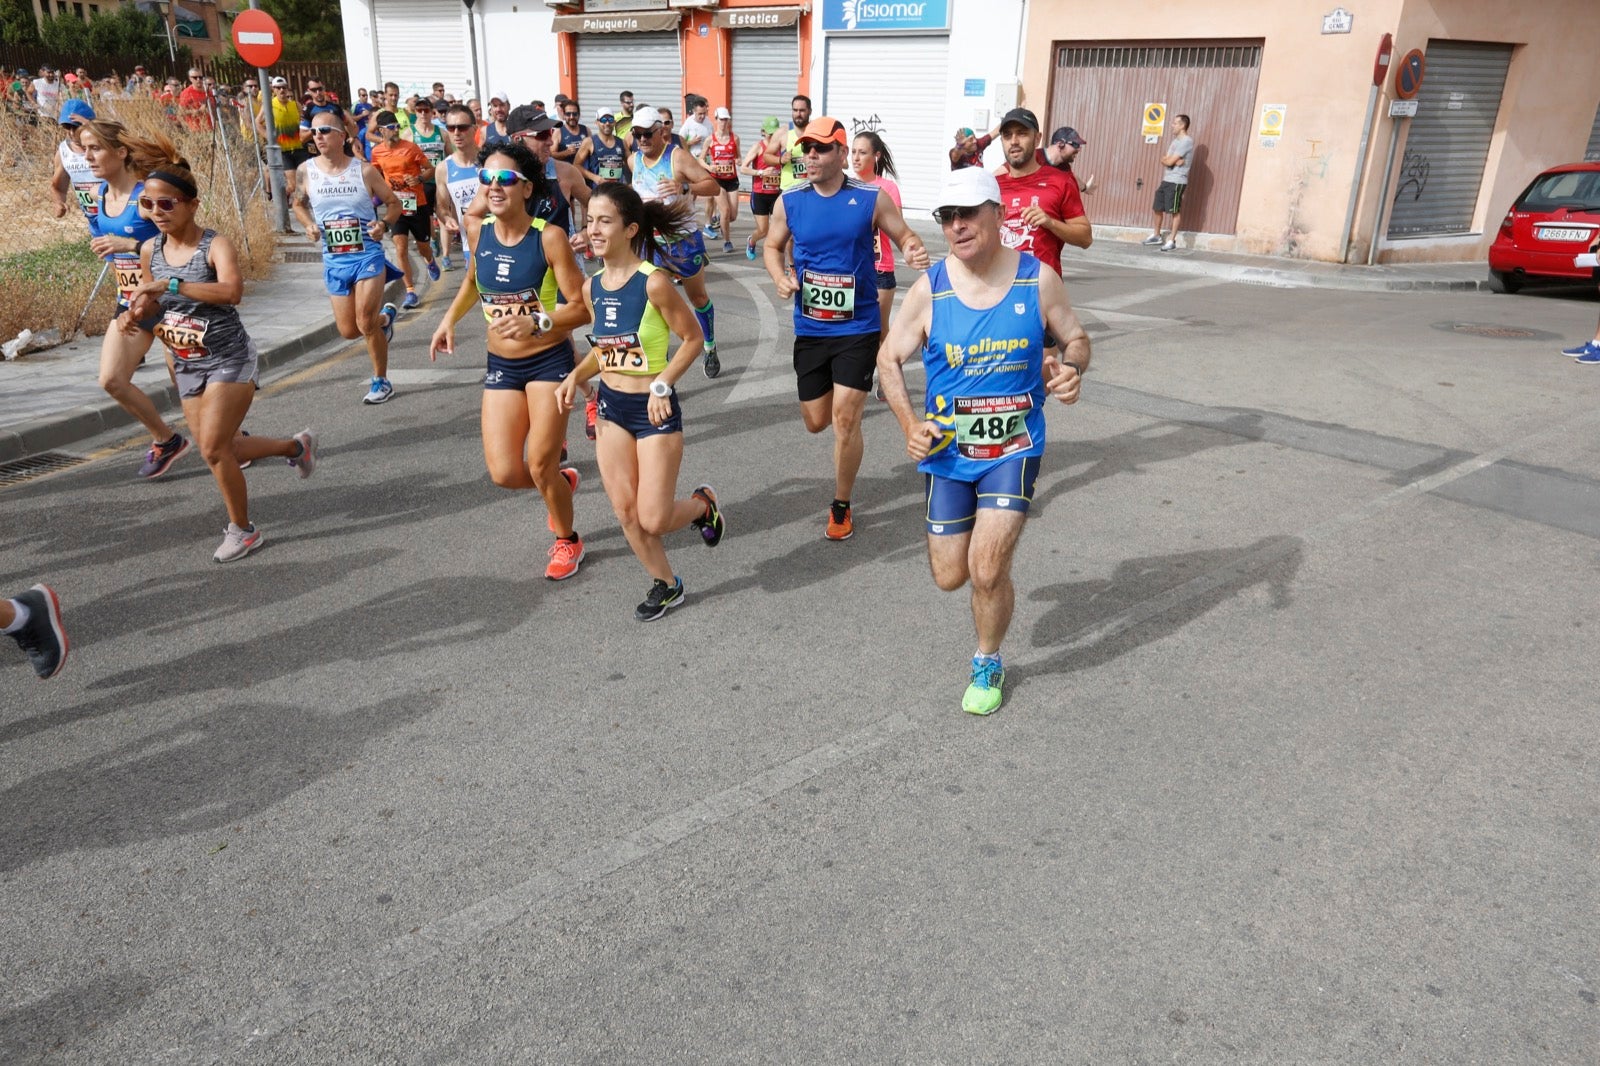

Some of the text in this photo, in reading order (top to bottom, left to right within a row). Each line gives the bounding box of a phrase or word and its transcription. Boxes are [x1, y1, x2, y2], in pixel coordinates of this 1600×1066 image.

[857, 0, 927, 22] fisiomar
[583, 18, 638, 30] Peluqueria
[729, 13, 779, 25] Estetica
[609, 169, 615, 177] 6
[317, 186, 358, 195] MARACENA
[327, 229, 360, 244] 1067
[810, 287, 846, 308] 290
[968, 338, 1028, 355] olimpo
[967, 354, 1005, 363] deportes
[971, 397, 986, 407] GRAN
[986, 395, 1006, 406] PREMIO
[969, 415, 1020, 440] 486
